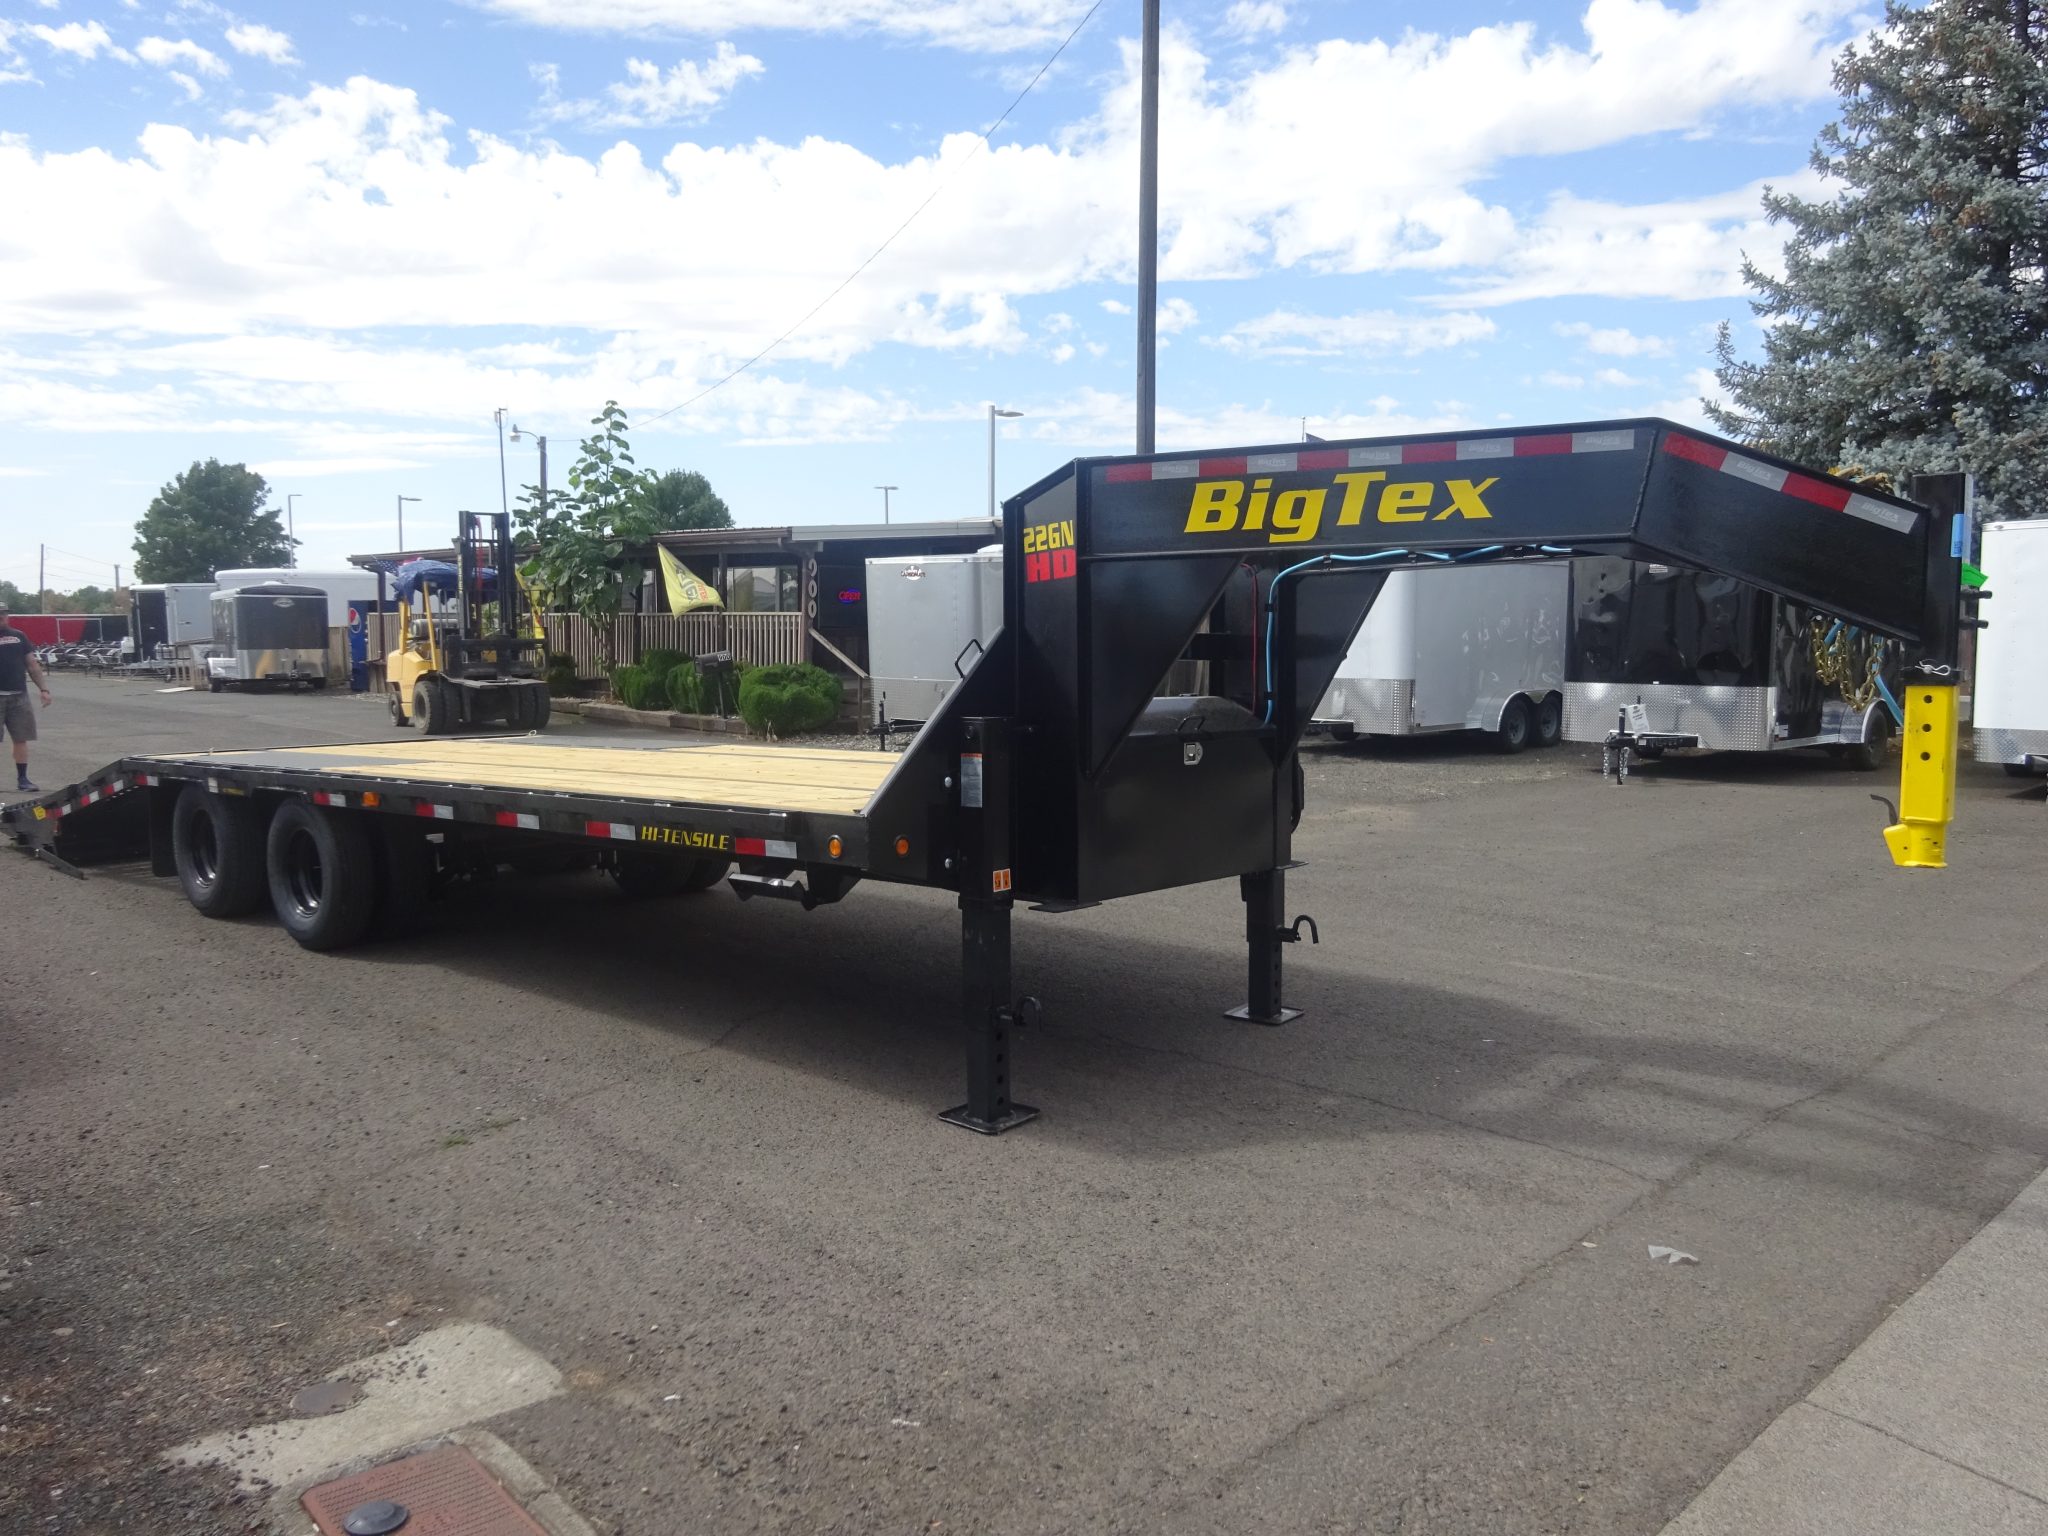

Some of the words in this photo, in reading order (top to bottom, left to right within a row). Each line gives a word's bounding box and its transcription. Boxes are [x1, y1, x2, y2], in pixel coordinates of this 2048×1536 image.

[1184, 471, 1501, 543] BigTex
[1023, 520, 1074, 554] 22GN
[1027, 549, 1077, 583] HD
[808, 558, 817, 618] 900
[839, 591, 862, 601] OPEN
[641, 826, 730, 850] HI-TENSILE
